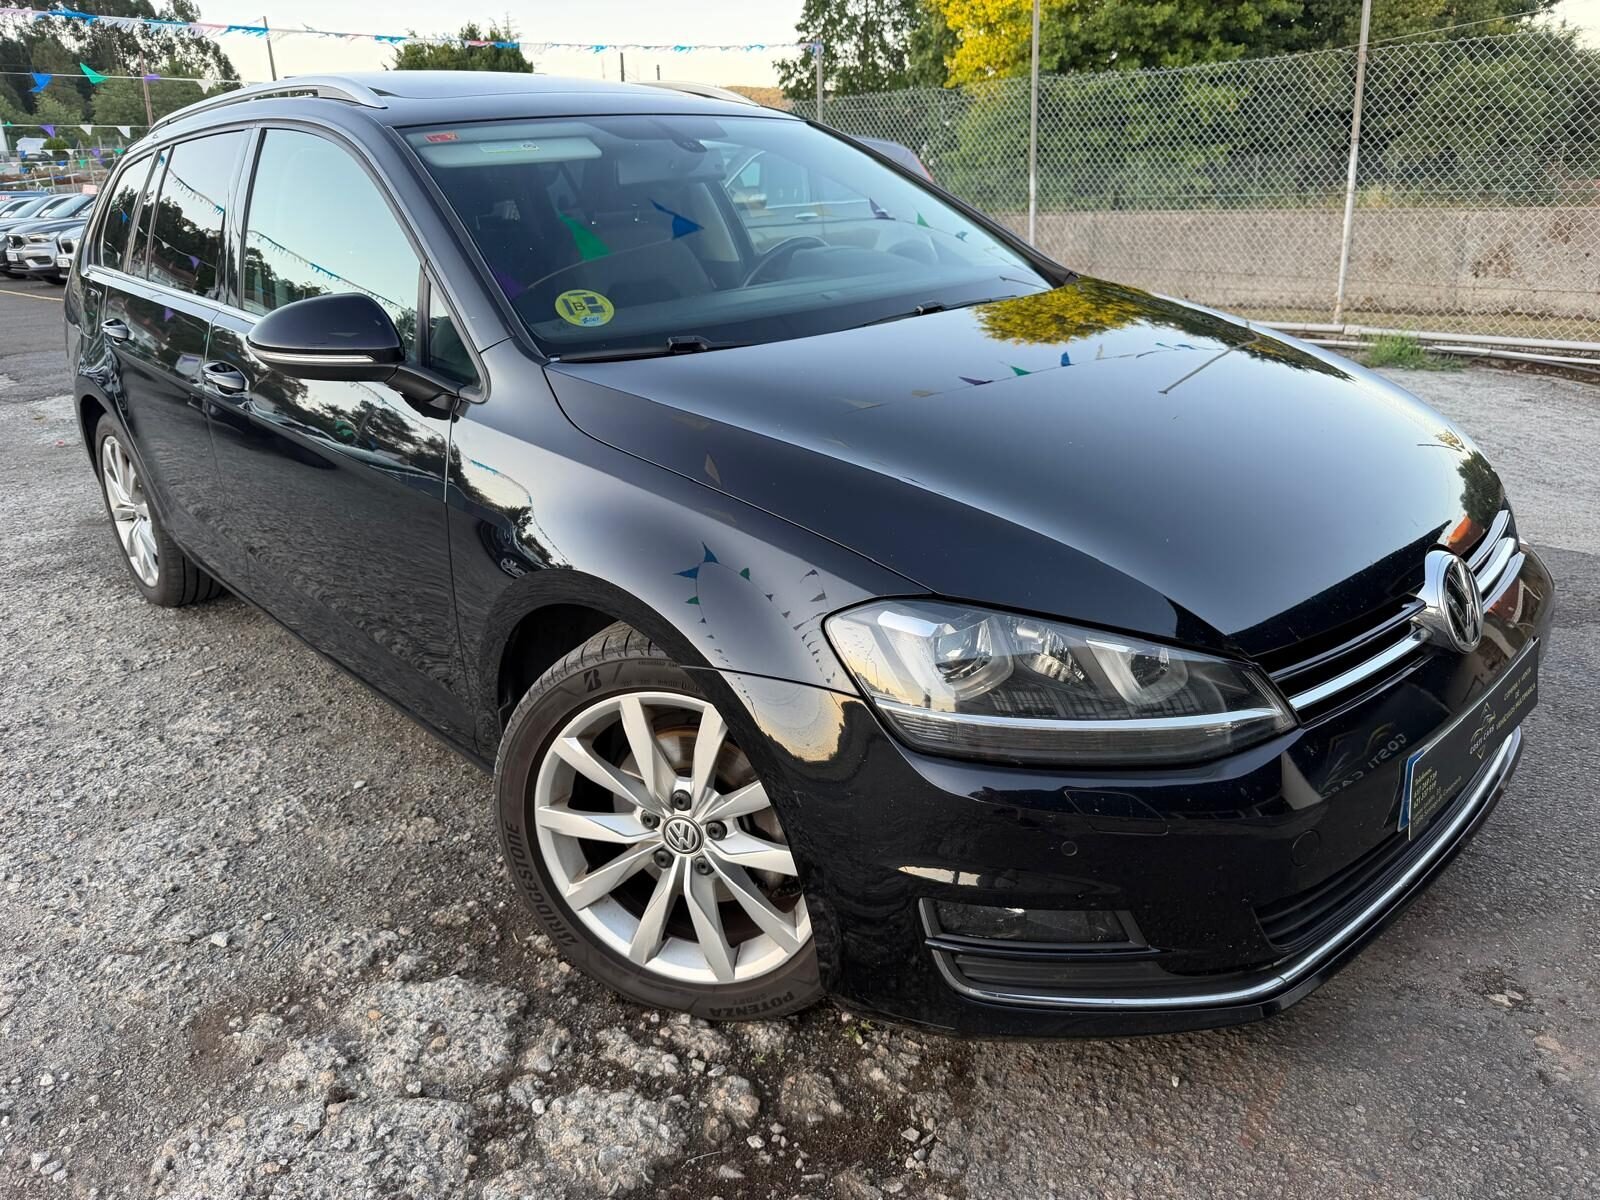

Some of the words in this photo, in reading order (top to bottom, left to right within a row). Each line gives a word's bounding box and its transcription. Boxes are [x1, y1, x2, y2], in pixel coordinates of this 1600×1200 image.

[573, 302, 586, 311] B
[505, 821, 579, 946] BRIDGESTONE
[709, 991, 795, 1017] POTENZA
